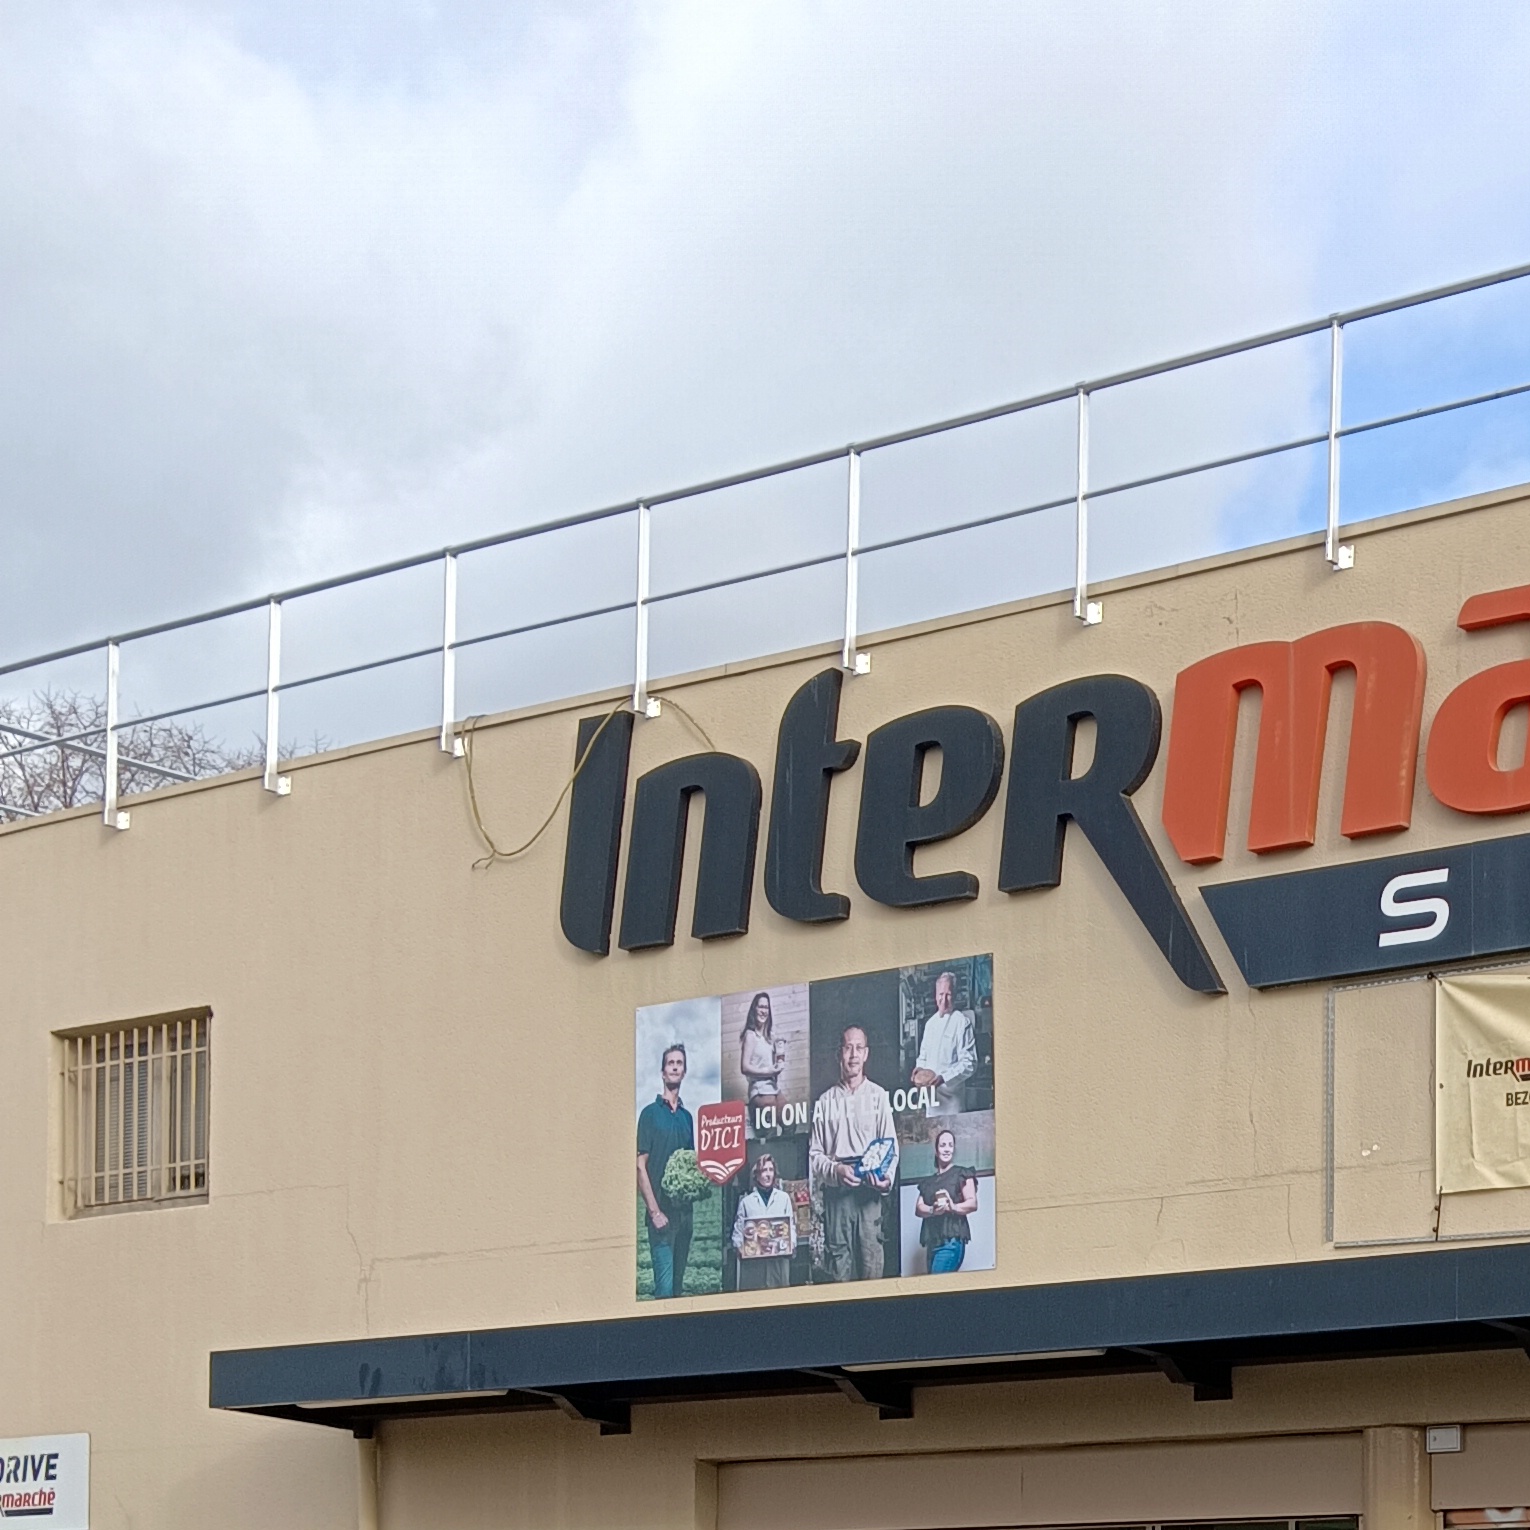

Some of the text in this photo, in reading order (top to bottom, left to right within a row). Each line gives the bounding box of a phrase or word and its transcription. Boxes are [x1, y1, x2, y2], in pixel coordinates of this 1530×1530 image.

[756, 1105, 777, 1130] ICI
[782, 1101, 808, 1127] ON
[884, 1085, 940, 1114] LOCAL
[701, 1114, 743, 1128] Producteurs
[701, 1126, 741, 1151] D'ICI
